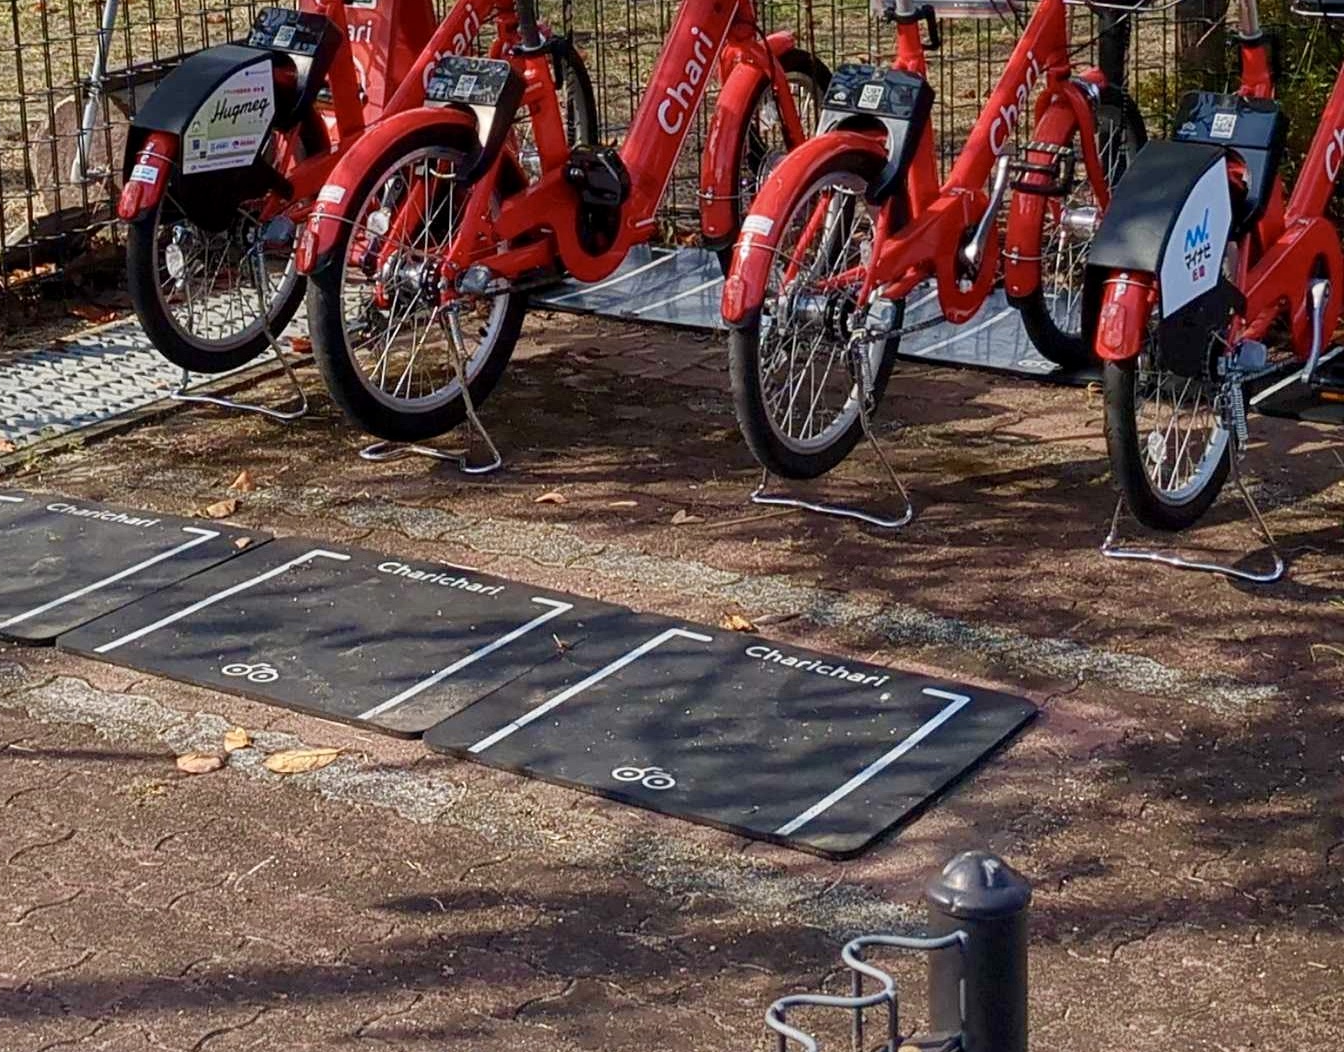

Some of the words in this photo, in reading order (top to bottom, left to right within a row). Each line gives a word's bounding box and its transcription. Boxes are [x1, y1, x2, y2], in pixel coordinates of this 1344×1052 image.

[658, 26, 713, 135] Chari
[46, 503, 161, 528] Charichari
[377, 562, 505, 596] Charichari
[745, 646, 890, 687] Charichari
